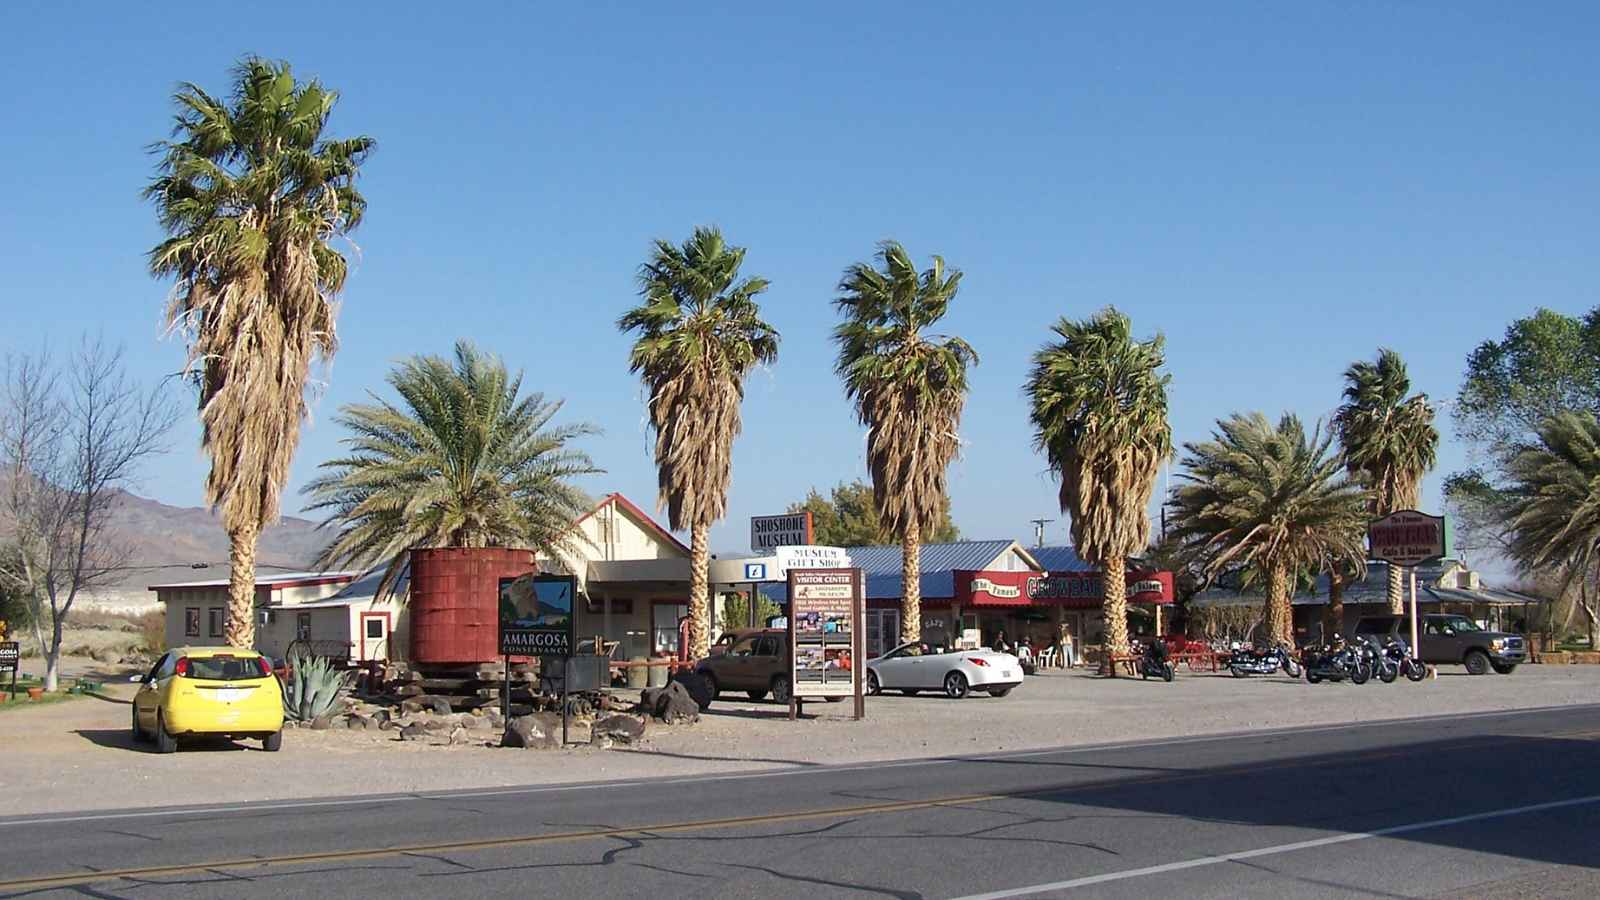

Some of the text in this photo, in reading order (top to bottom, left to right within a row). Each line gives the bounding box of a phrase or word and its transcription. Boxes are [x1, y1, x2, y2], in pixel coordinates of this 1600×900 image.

[755, 516, 805, 533] SHOSHONE
[758, 532, 802, 548] MUSEUM
[795, 549, 837, 558] MUSEUM
[787, 559, 841, 568] GIFT SHOP
[796, 576, 850, 584] VISITOR CENTER
[503, 633, 569, 646] AMARGOSA
[503, 646, 569, 654] CONSERVANCY
